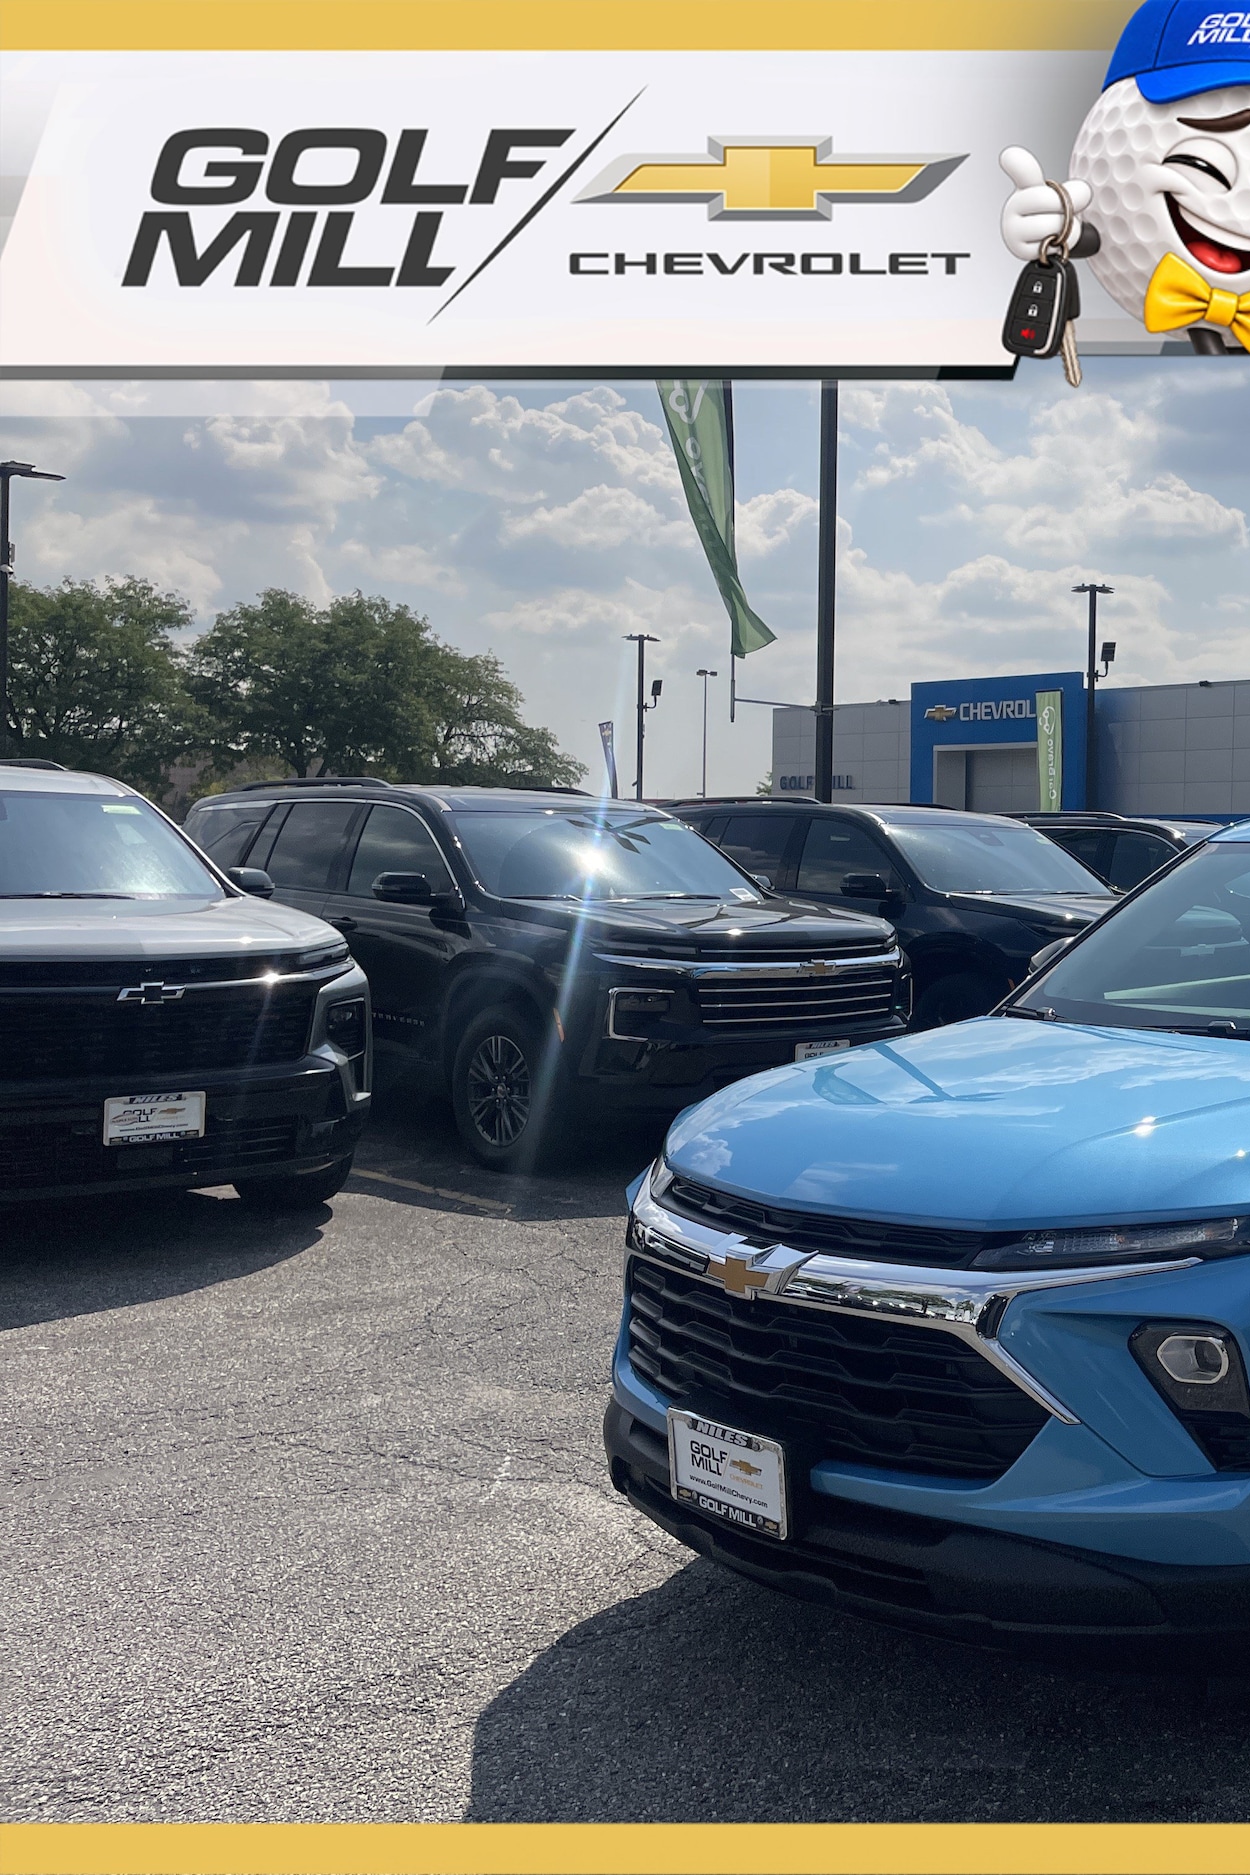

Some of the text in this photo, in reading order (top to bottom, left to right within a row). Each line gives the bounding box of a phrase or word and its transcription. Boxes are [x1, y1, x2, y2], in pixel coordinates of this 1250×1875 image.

[960, 699, 1036, 721] CHEVROL
[780, 775, 855, 790] GOLF ILL
[132, 1095, 178, 1104] NILES
[129, 1131, 180, 1143] GOLF MILL
[696, 1421, 748, 1447] NILES
[690, 1440, 728, 1465] GOLF
[691, 1454, 723, 1477] MILL
[699, 1495, 757, 1528] GOLF MILL
